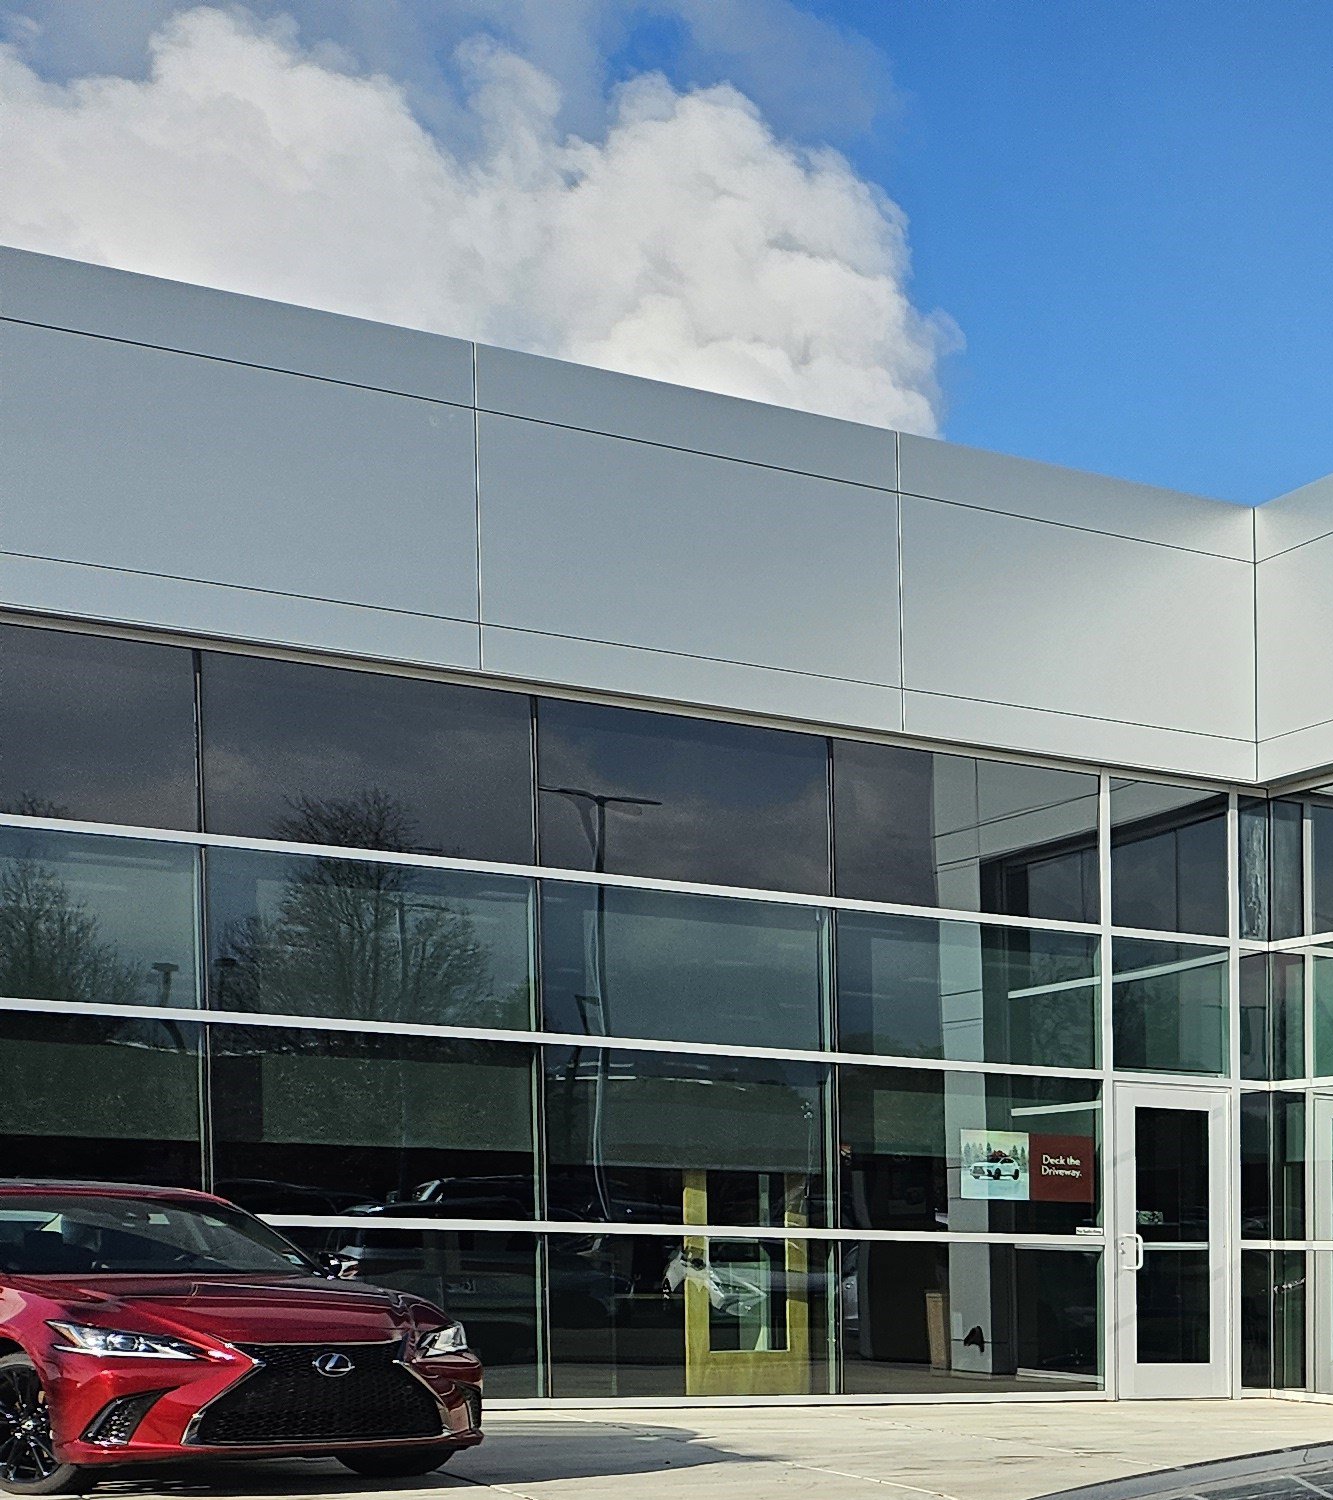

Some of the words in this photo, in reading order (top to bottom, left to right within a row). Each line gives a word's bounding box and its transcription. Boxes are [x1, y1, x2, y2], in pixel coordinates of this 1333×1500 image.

[1042, 1154, 1065, 1165] Deck
[1066, 1155, 1080, 1165] the
[1041, 1165, 1082, 1178] Driveway.
